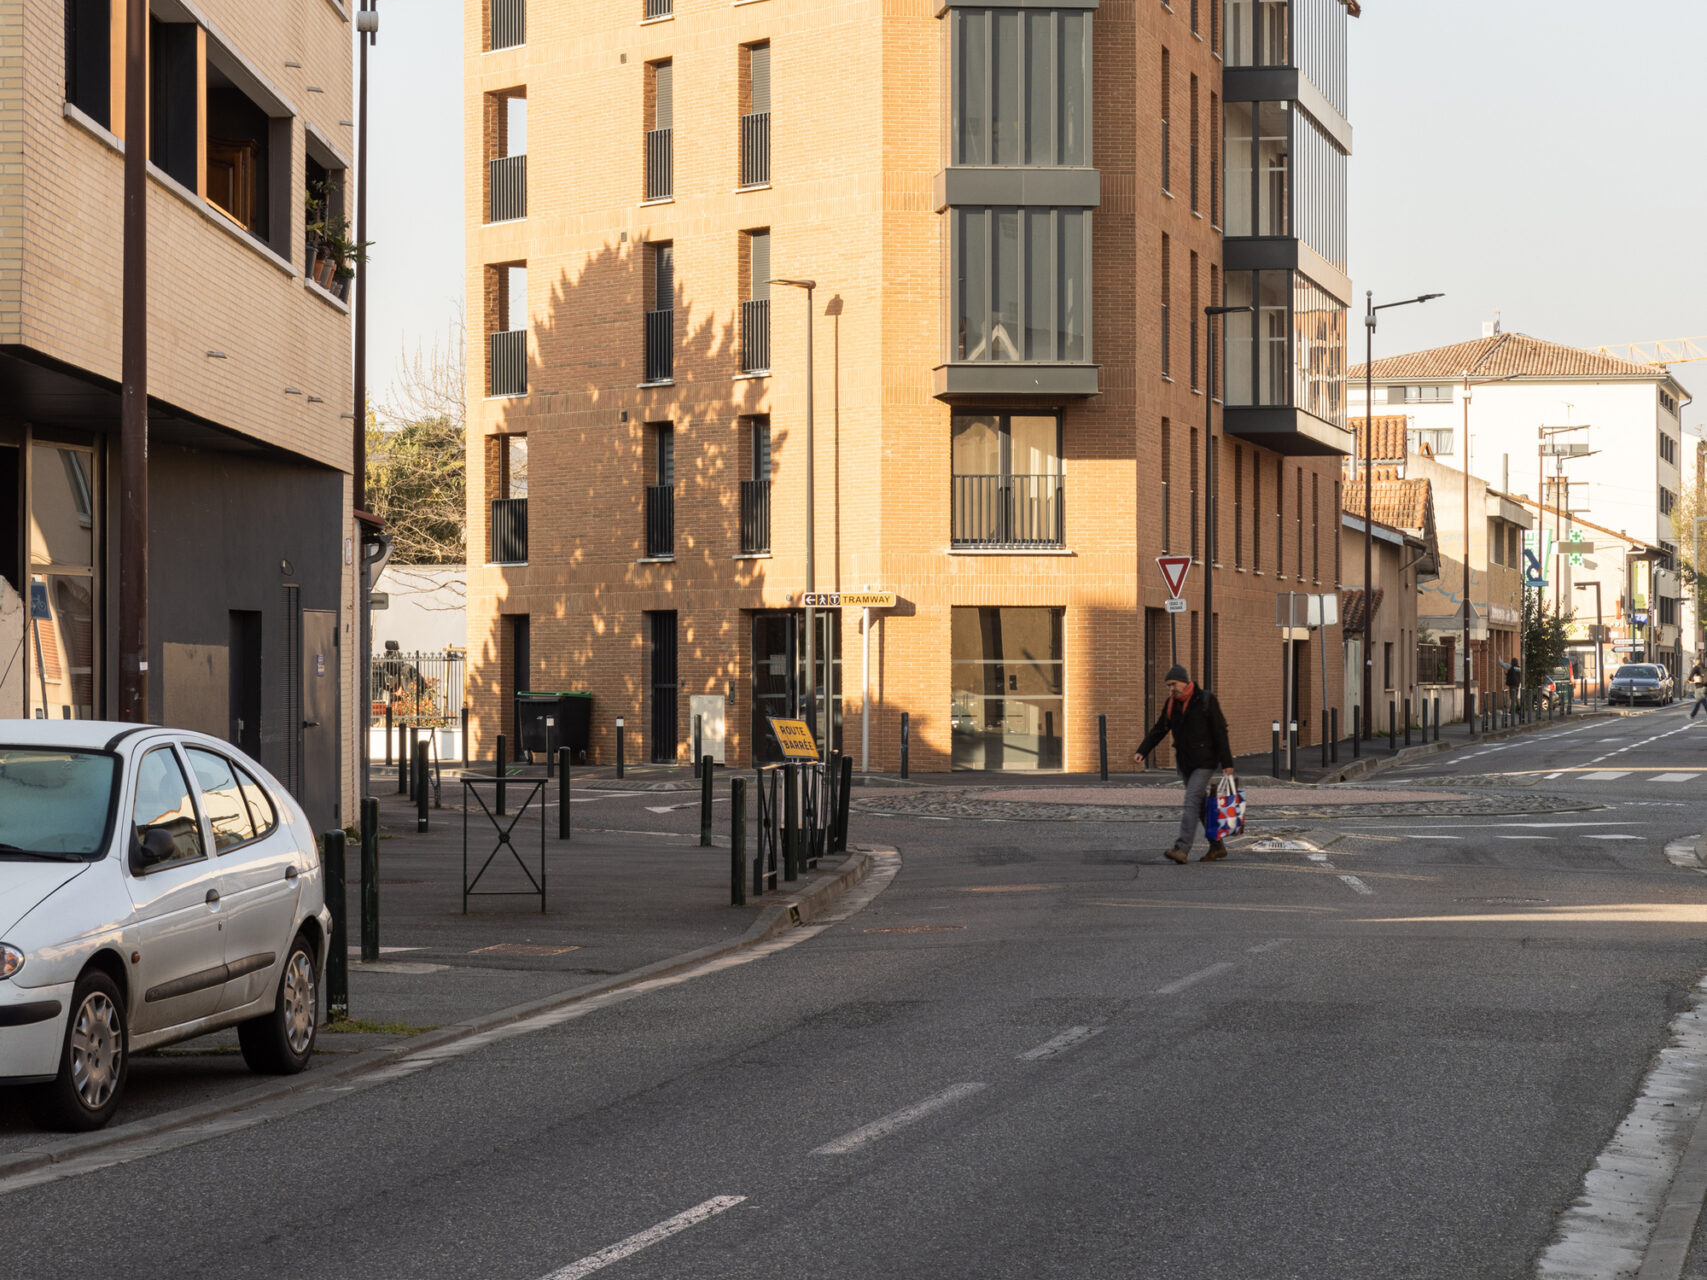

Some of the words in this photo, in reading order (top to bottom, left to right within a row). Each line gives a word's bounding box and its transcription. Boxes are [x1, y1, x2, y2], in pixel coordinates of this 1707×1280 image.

[843, 595, 890, 603] TRAMWAY
[779, 725, 806, 736] ROUTE
[782, 739, 814, 751] BARRÉE
